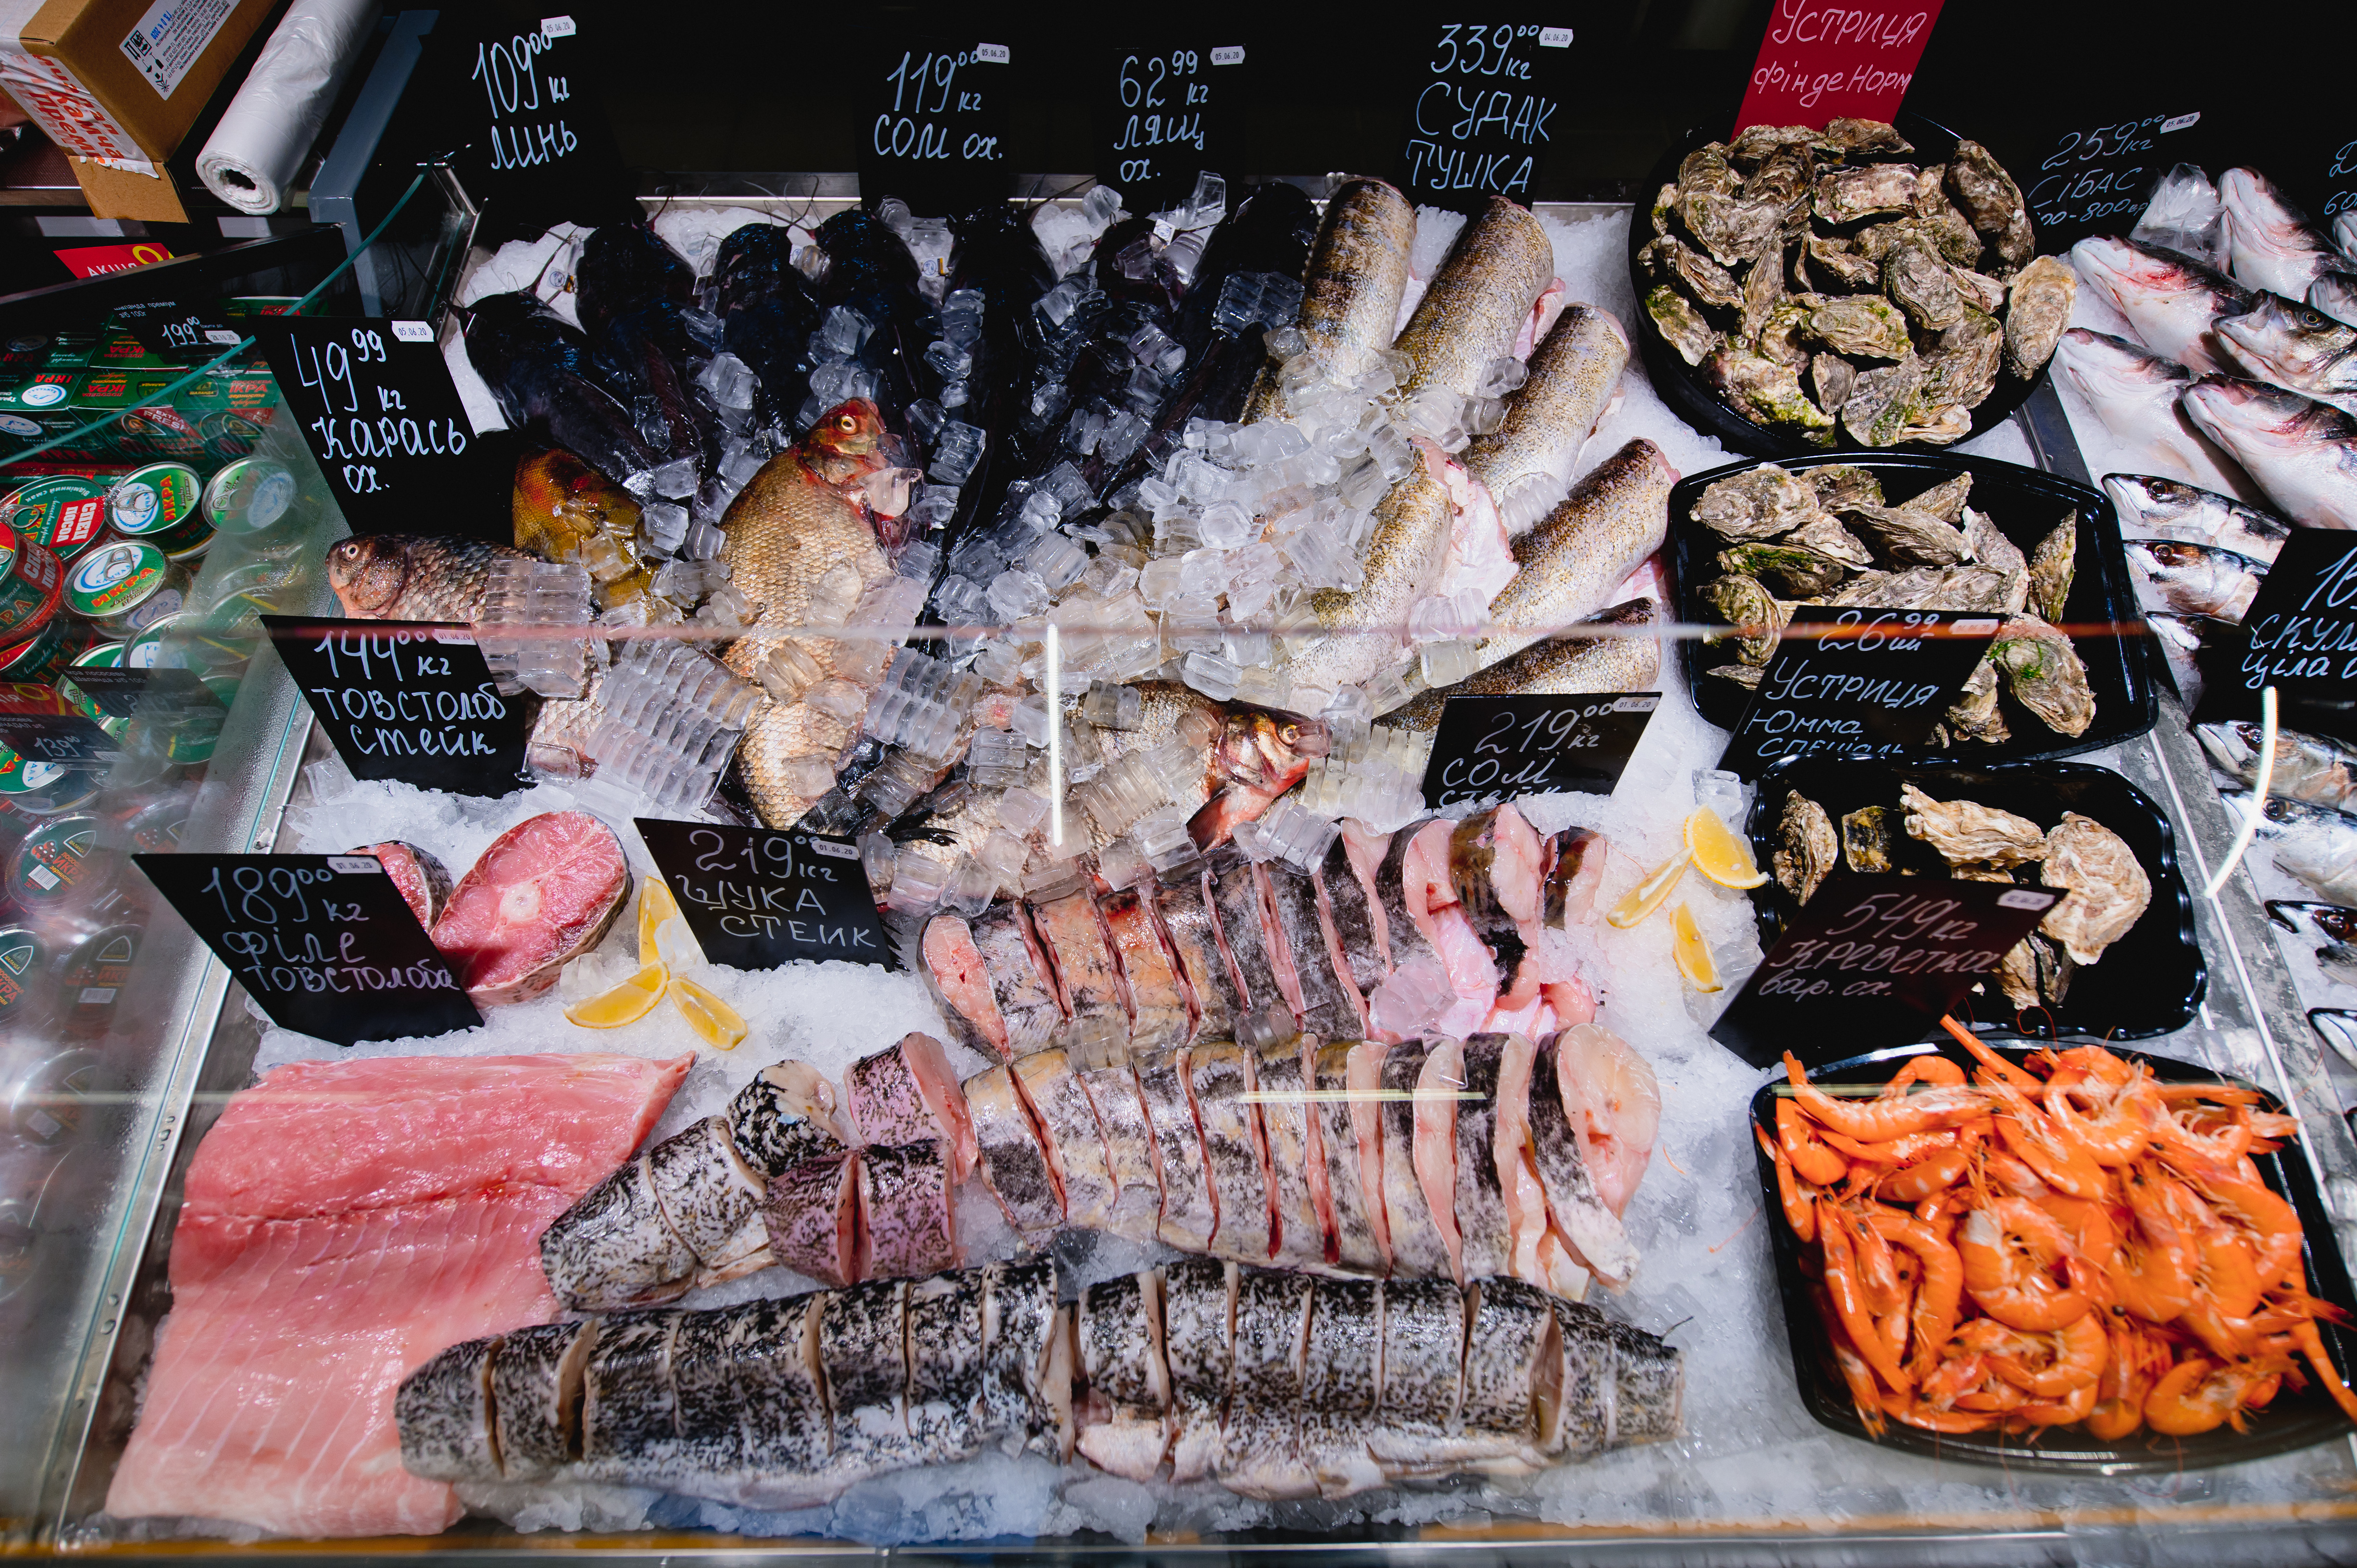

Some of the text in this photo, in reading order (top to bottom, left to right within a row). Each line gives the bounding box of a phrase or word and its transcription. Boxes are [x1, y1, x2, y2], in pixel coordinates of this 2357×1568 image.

[546, 22, 570, 33] 05.06.20
[1545, 33, 1569, 42] 04.06.20
[981, 48, 1006, 59] 05.06.20
[1215, 51, 1239, 61] 05.06.20
[1416, 82, 1556, 144] СУДАК
[2166, 115, 2195, 128] 05.06.20
[1406, 139, 1533, 194] ТУШКА
[399, 327, 426, 336] 05.06.20
[143, 410, 190, 432] FRESH
[156, 410, 184, 424] EXTRA
[161, 475, 176, 522] ИКРА
[56, 506, 78, 542] ПОСОЛ
[72, 502, 97, 541] СПЕЦ
[91, 568, 156, 607] ИКРА
[1619, 700, 1651, 709] 01.06.20
[819, 844, 853, 855] 01.06.20
